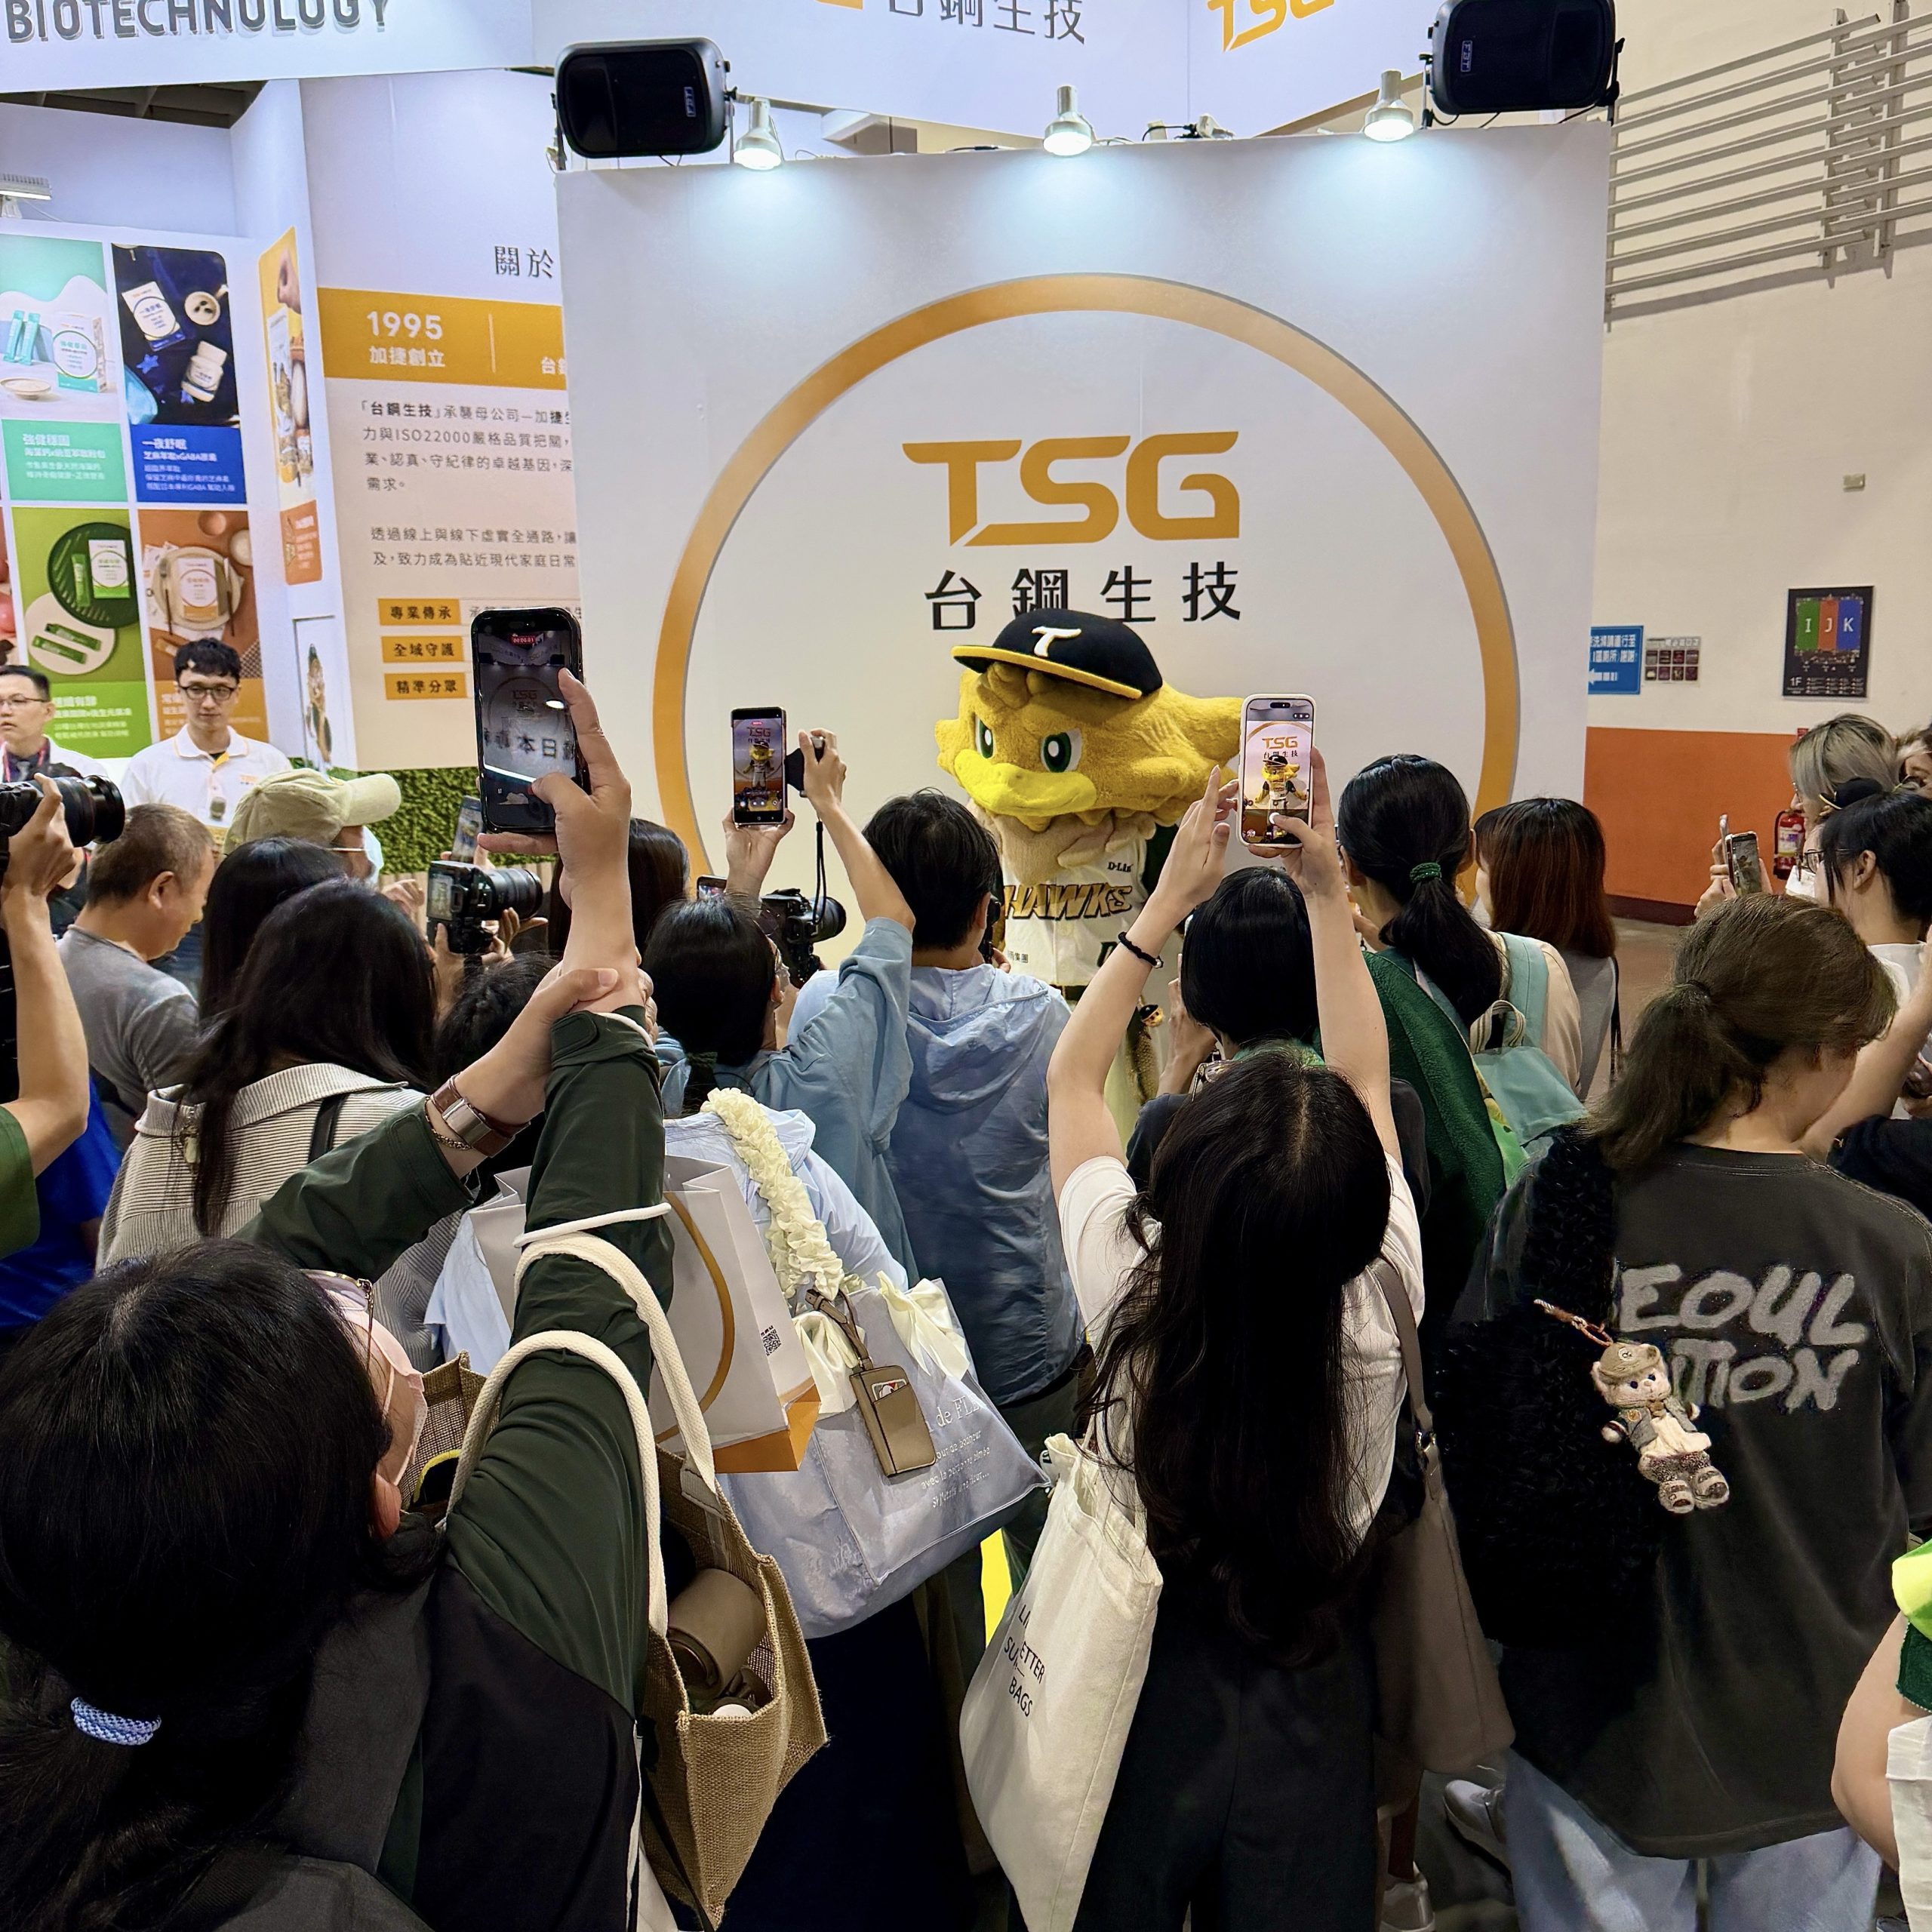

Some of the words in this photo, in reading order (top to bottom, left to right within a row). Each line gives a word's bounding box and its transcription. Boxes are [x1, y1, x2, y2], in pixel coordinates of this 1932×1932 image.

[494, 245, 553, 278] 關於
[367, 311, 443, 340] 1995
[368, 346, 446, 368] 加捷創立
[902, 431, 1240, 547] TSG
[924, 561, 1241, 631] 台鋼生技
[1805, 618, 1812, 633] I
[1824, 617, 1833, 632] J
[1843, 617, 1854, 632] K
[393, 642, 454, 657] 全域守護
[1031, 626, 1082, 657] T
[1261, 736, 1298, 749] TSG
[1004, 882, 1132, 921] HAWKS
[1618, 1263, 1870, 1349] EOUL
[936, 1406, 952, 1428] de
[921, 1475, 940, 1490] avec
[1008, 1676, 1033, 1718] BAGS
